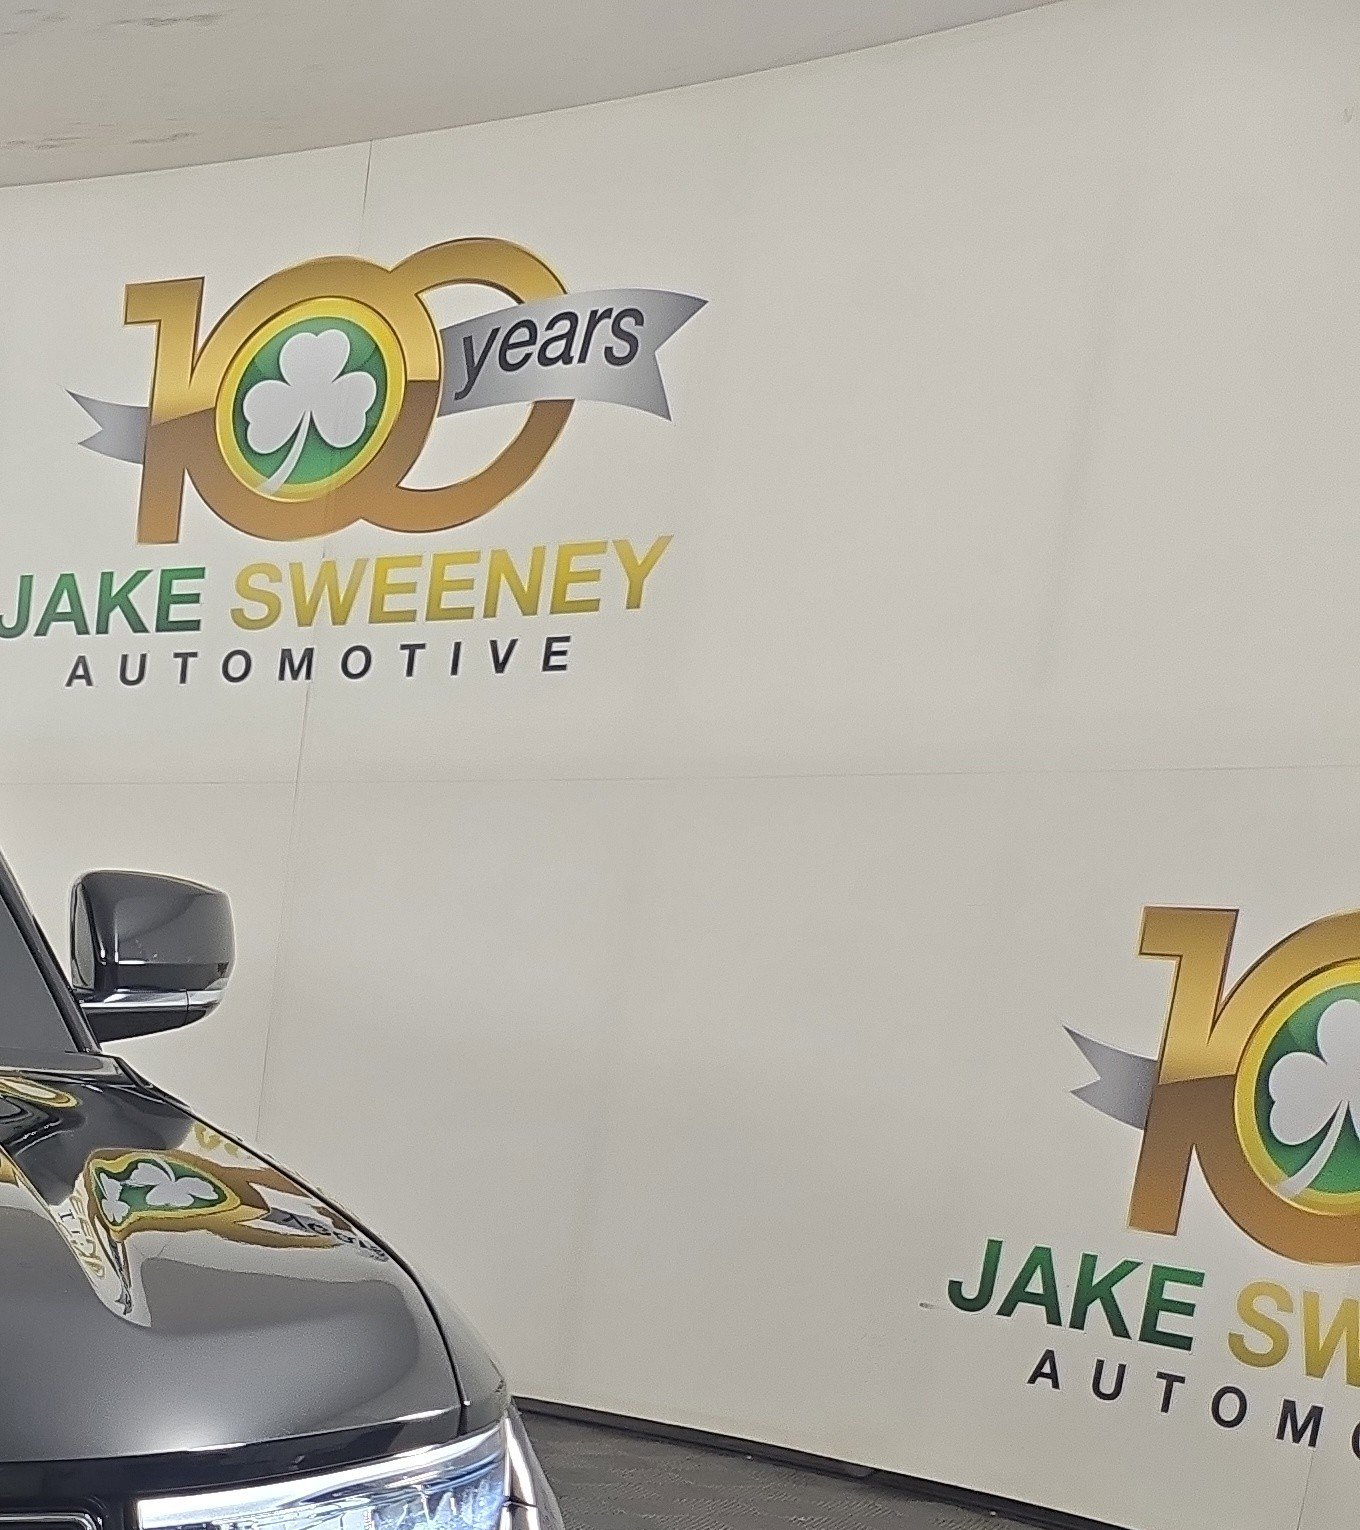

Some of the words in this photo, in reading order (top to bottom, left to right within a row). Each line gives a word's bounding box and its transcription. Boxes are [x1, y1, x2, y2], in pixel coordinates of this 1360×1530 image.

[453, 306, 645, 401] years
[230, 535, 675, 631] SWEENEY
[65, 635, 572, 687] AUTOMOTIVE
[947, 1238, 1205, 1351] JAKE
[1027, 1349, 1360, 1463] AUTOM
